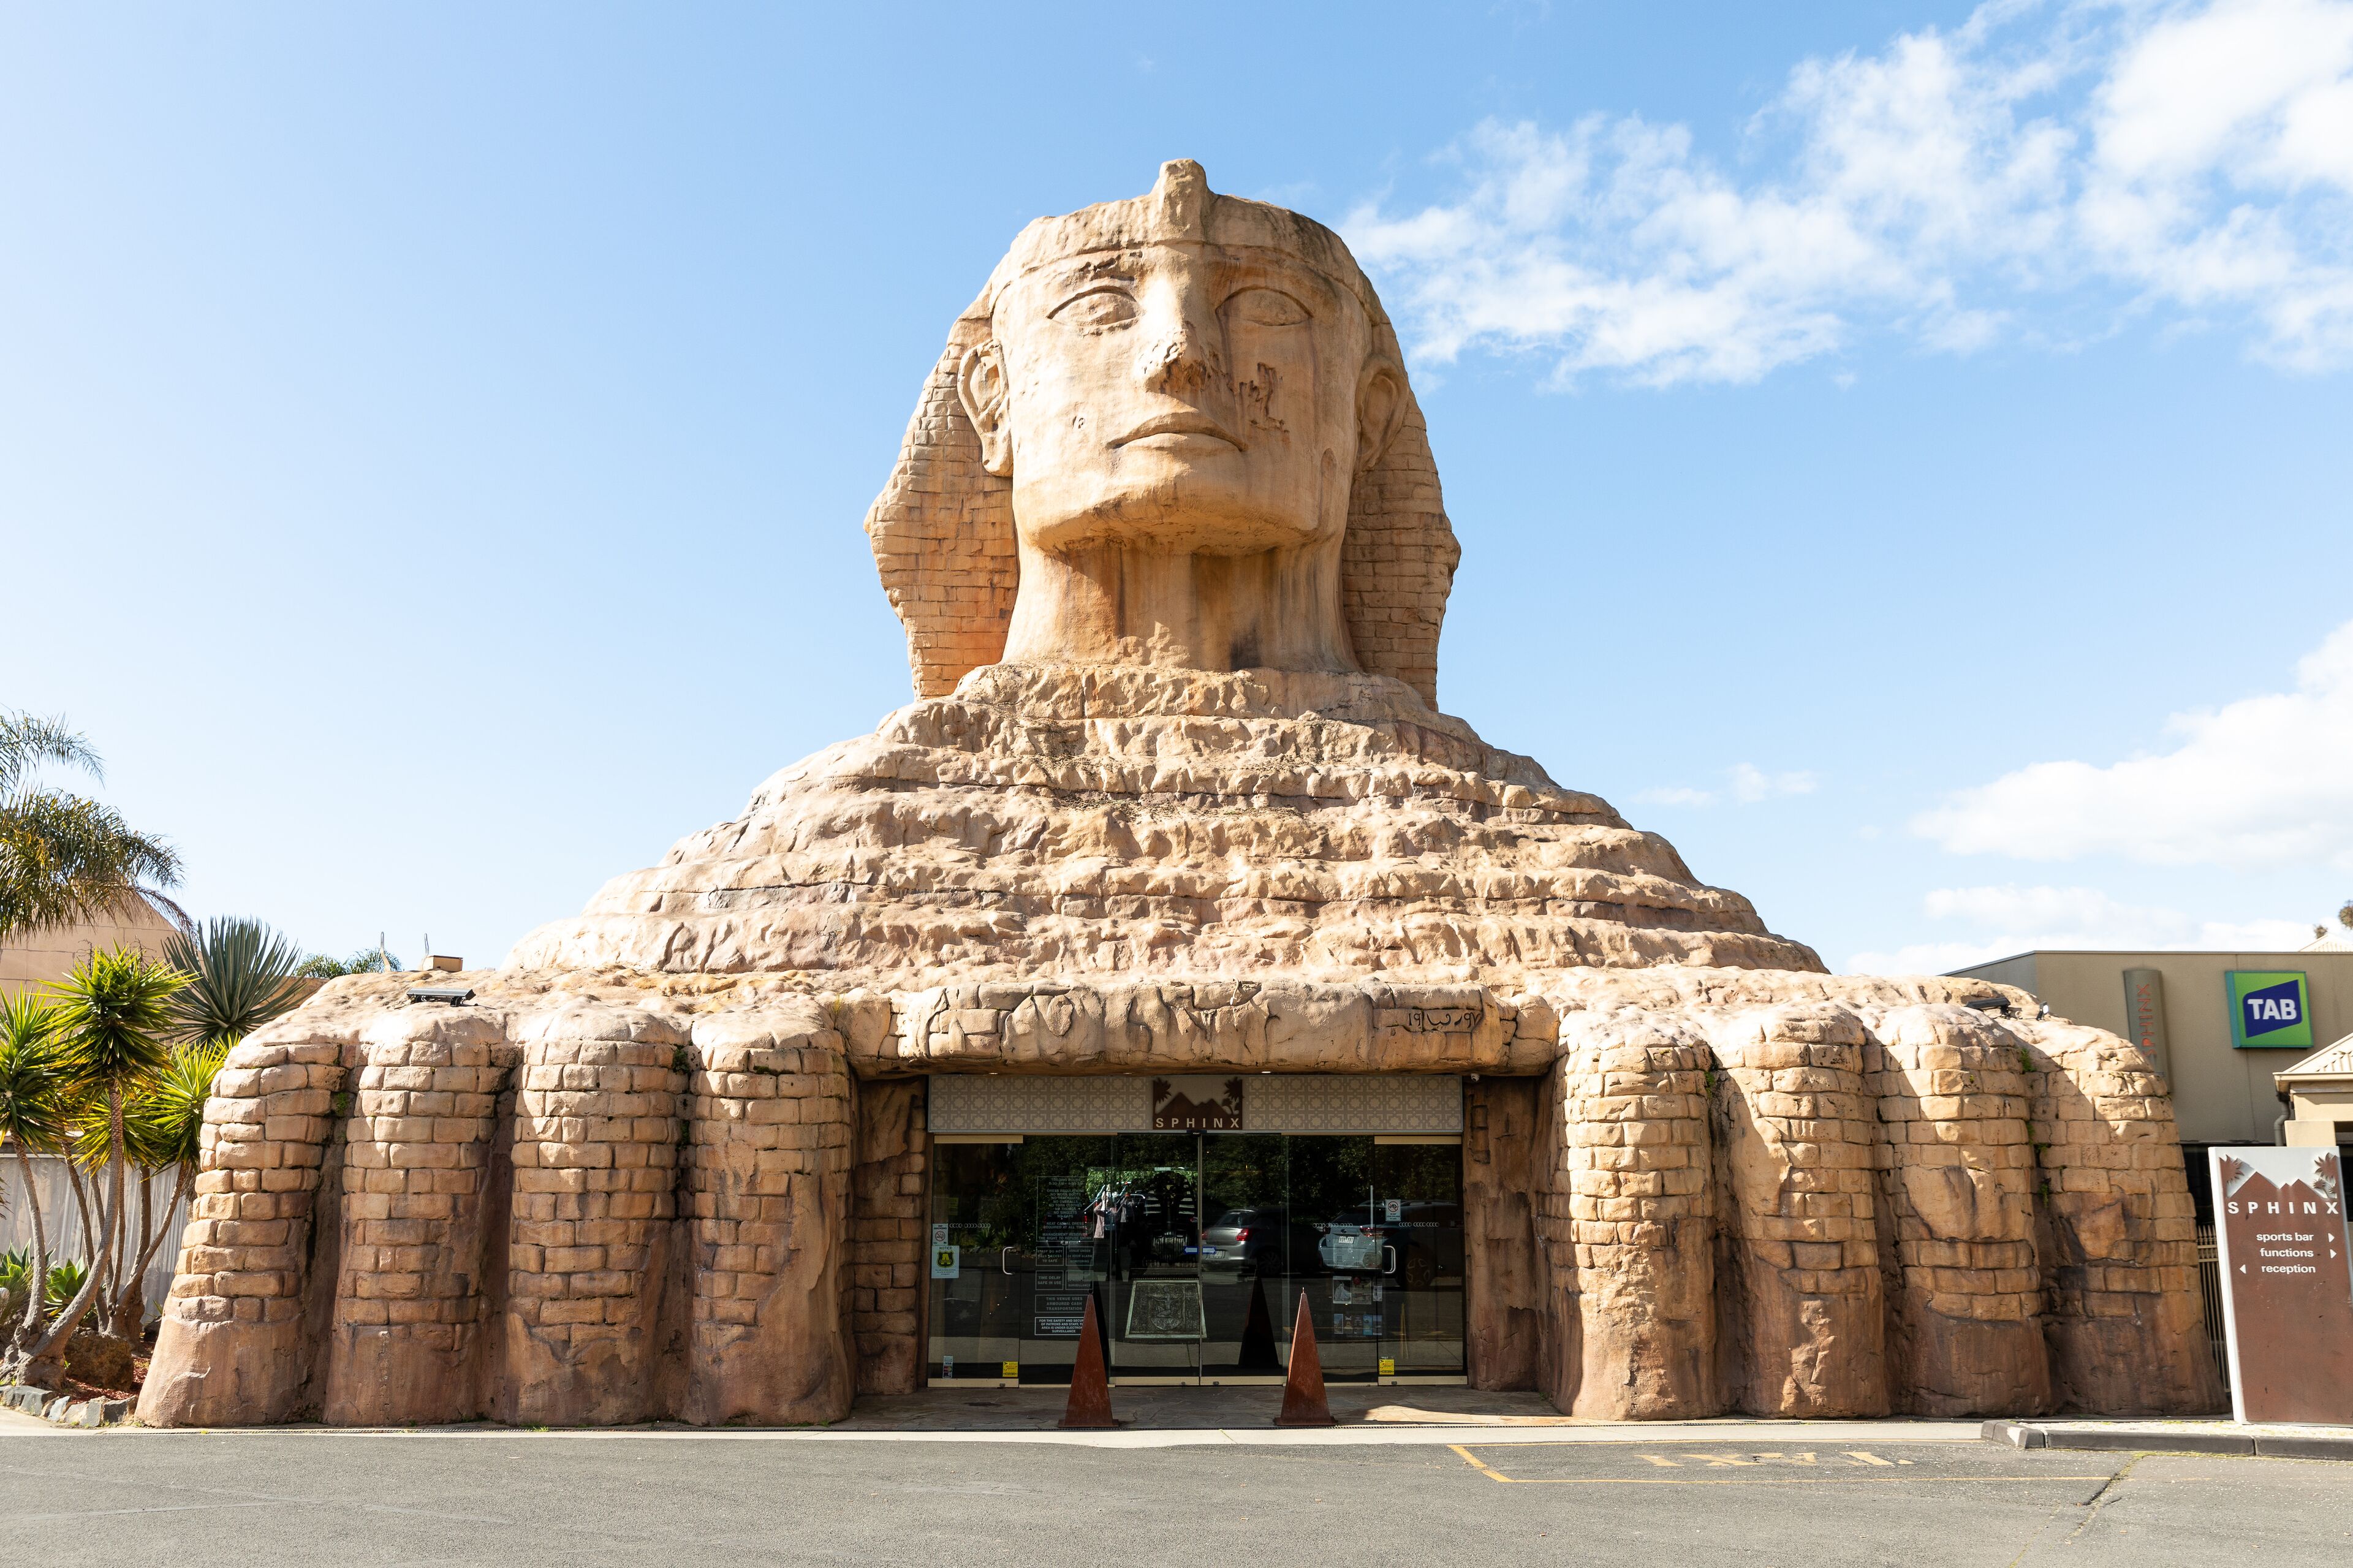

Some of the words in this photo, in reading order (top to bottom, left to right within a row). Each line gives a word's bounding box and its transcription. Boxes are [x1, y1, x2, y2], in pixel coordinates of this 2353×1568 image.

[2247, 999, 2297, 1020] TAB
[2137, 983, 2158, 1058] SPHINX
[1156, 1118, 1239, 1128] SPHINX
[2227, 1202, 2339, 1214] SPHINX
[2256, 1233, 2292, 1241] sports
[2295, 1232, 2314, 1241] bar
[2259, 1248, 2314, 1257] functions
[2261, 1263, 2316, 1274] reception
